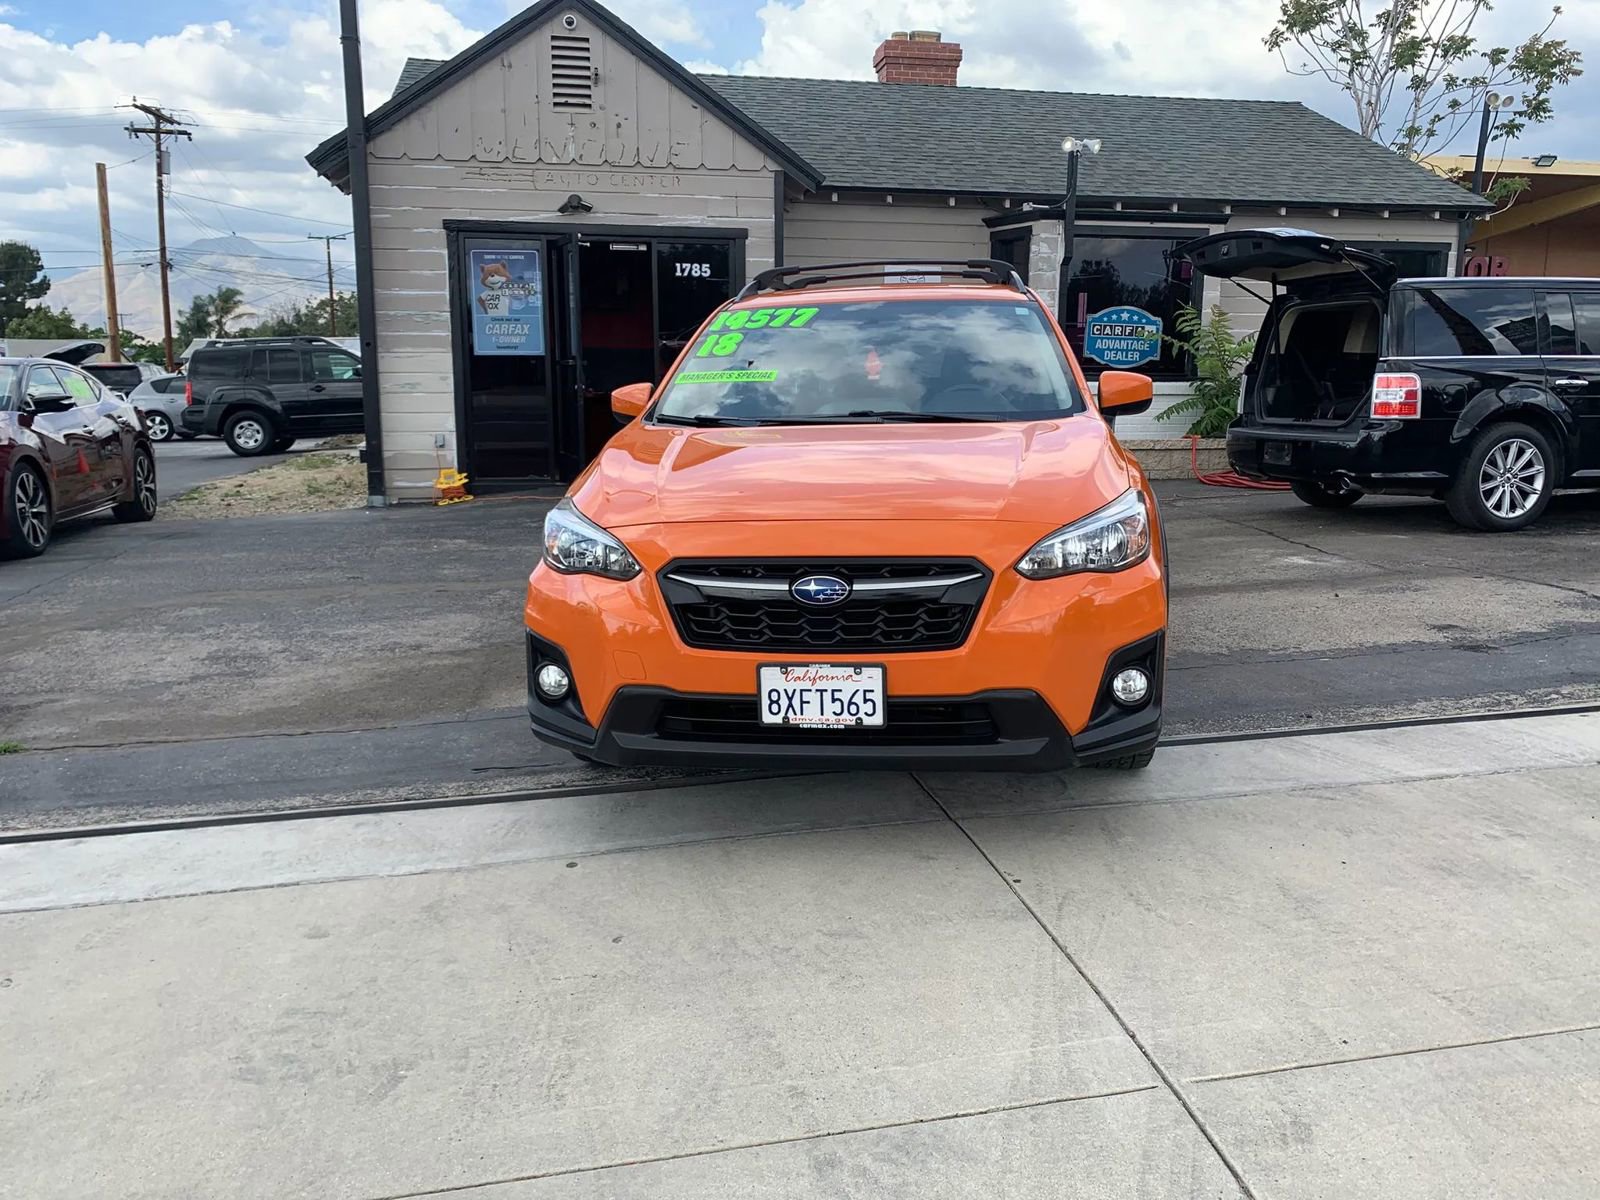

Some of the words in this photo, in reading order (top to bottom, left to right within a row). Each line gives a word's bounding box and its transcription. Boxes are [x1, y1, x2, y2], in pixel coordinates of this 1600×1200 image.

[675, 262, 711, 278] 1785
[708, 307, 819, 331] 14577
[485, 323, 530, 335] CARFAX
[696, 332, 744, 357] 18
[1095, 338, 1150, 350] ADVANTAGE
[1104, 350, 1140, 361] DEALER
[680, 371, 734, 381] MANAGER'S
[735, 370, 775, 380] SPECIAL
[784, 668, 862, 686] California
[768, 688, 876, 716] 8XFT565
